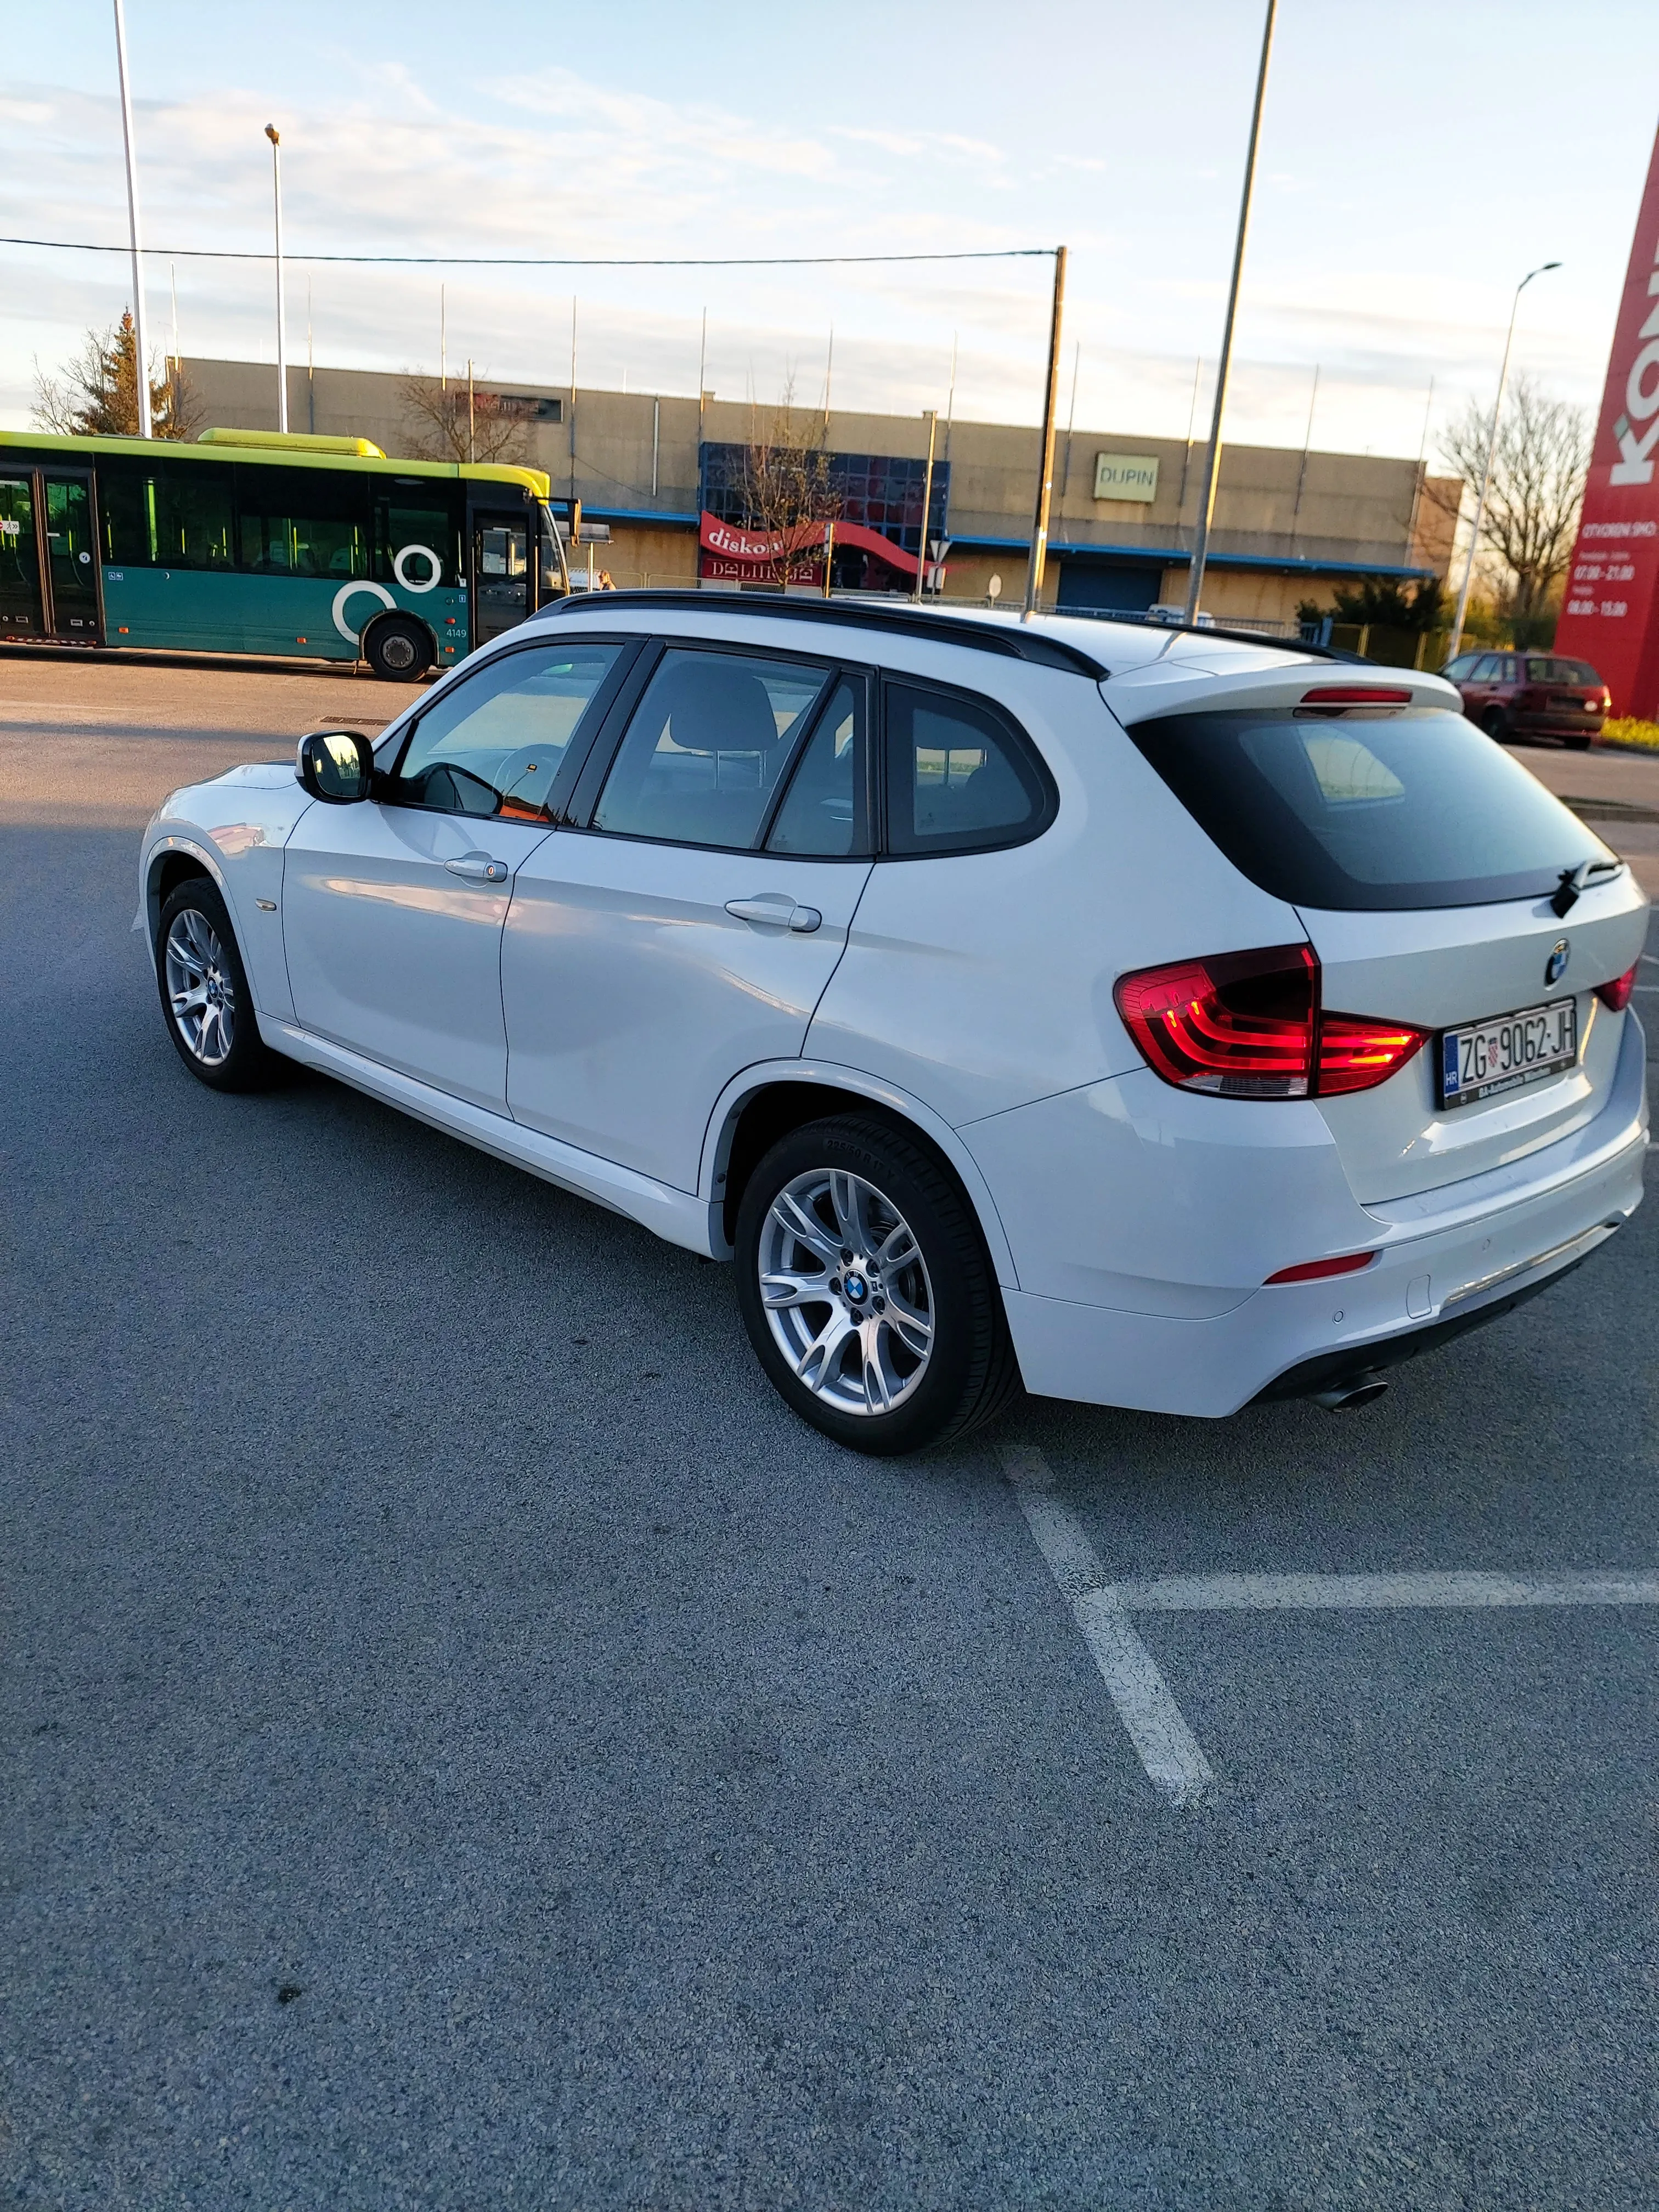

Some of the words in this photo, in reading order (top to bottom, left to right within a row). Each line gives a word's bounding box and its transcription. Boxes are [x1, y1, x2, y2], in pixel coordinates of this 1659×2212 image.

[1099, 467, 1154, 487] DUPIN
[446, 628, 467, 637] 4149
[1460, 1035, 1486, 1084] ZG
[1446, 1070, 1459, 1086] HR
